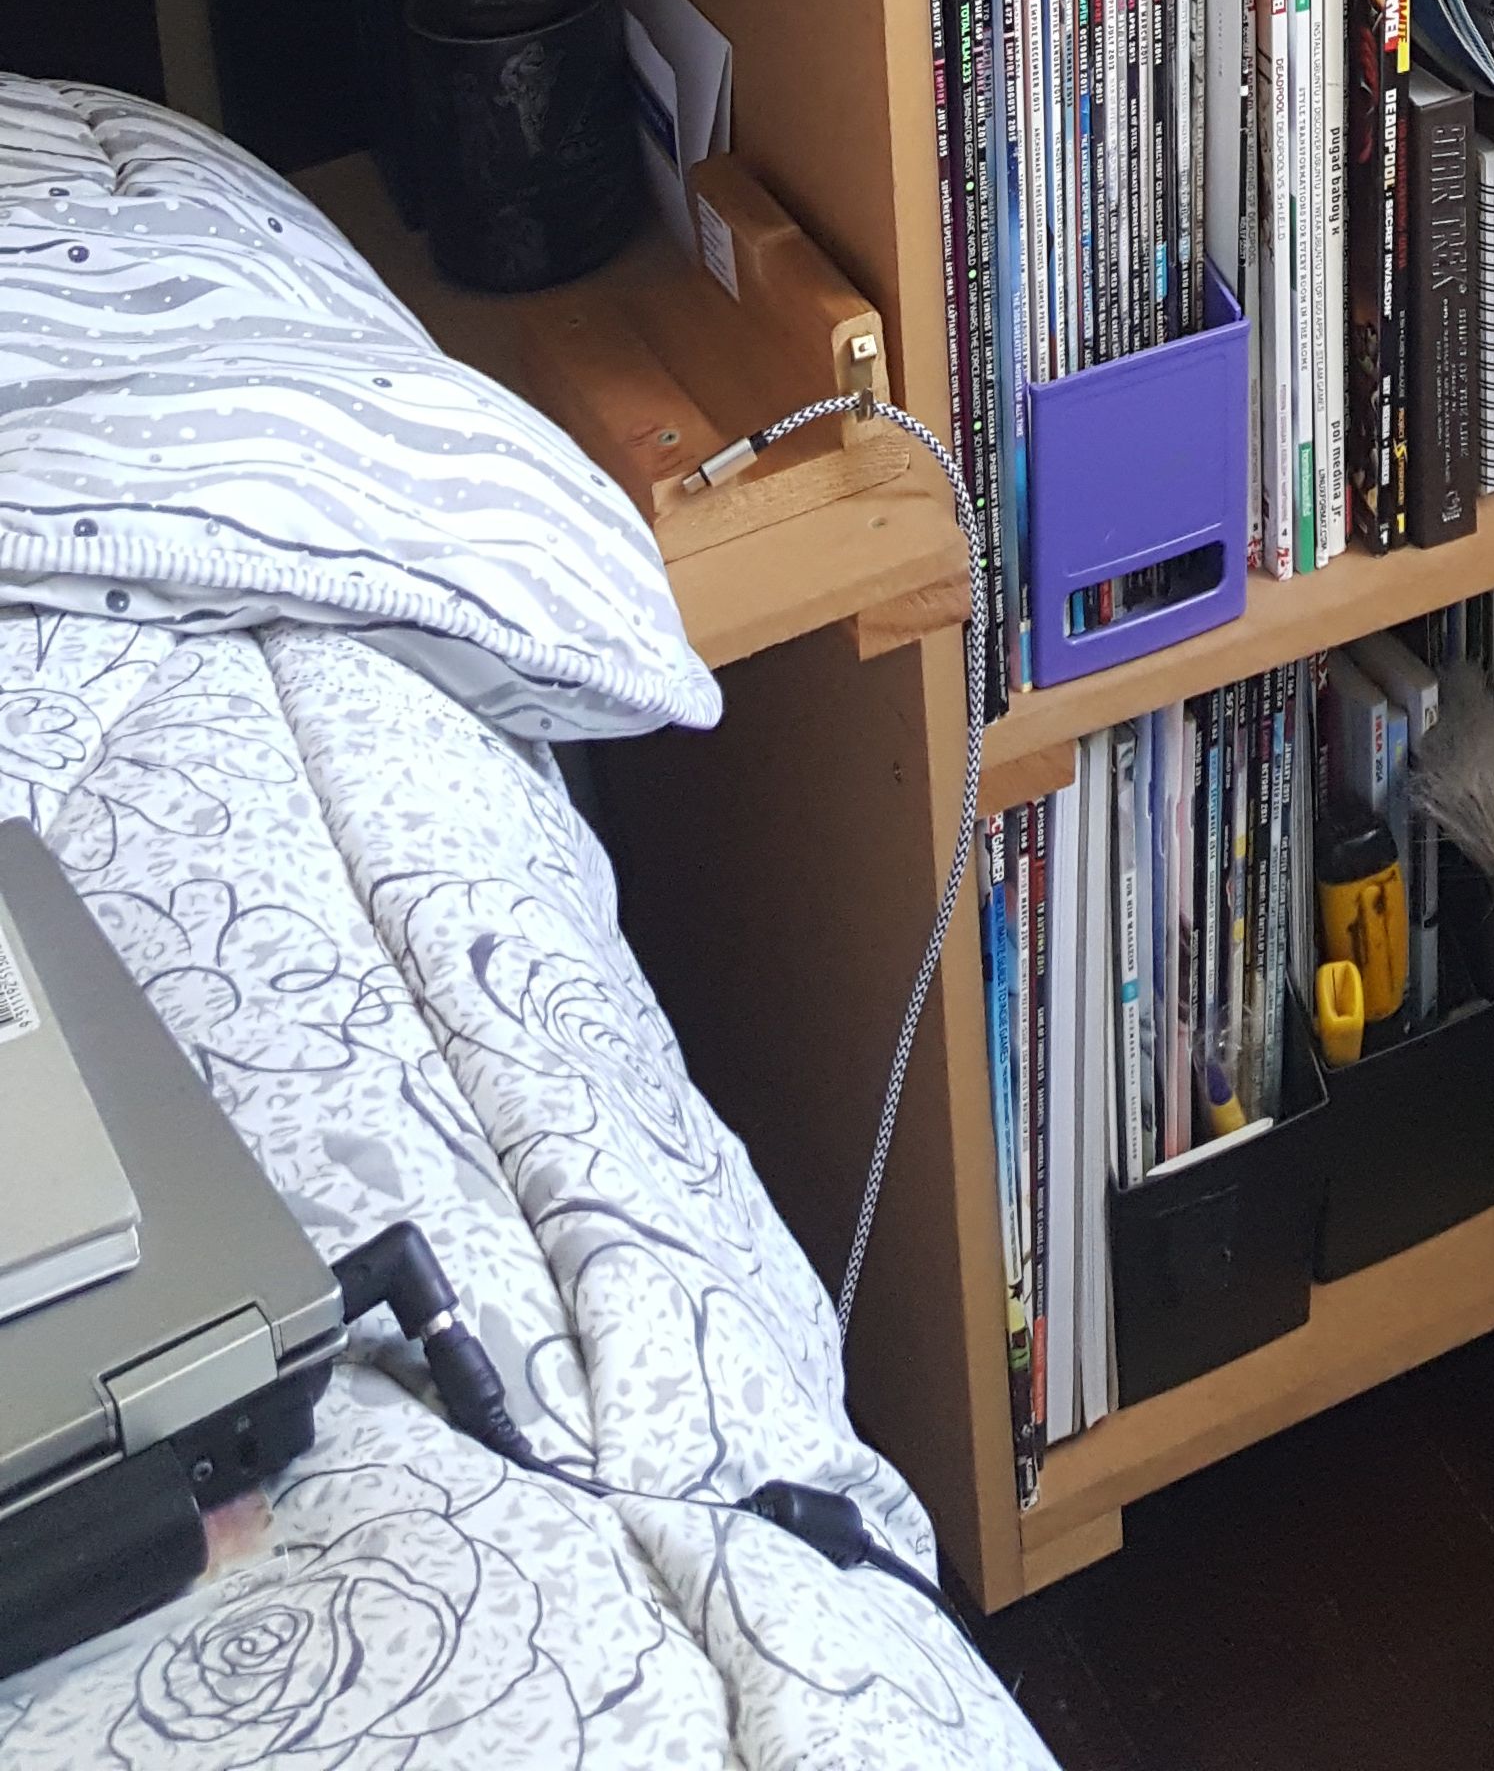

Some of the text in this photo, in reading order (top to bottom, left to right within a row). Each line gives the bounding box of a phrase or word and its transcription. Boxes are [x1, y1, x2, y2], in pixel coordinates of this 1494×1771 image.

[1128, 12, 1136, 40] APRIL
[1154, 4, 1162, 65] AUGUST 2014
[1313, 22, 1322, 58] INSTALL
[1031, 39, 1040, 90] DECEMBER
[1053, 39, 1061, 79] JANUARY
[1079, 28, 1088, 69] OCTOBER
[1095, 26, 1103, 80] SEPTEMBER
[934, 30, 948, 157] 172 JULY 2015
[976, 95, 985, 125] APRIL
[1006, 80, 1016, 117] AUGUST
[1328, 127, 1342, 227] pugad baboy
[1431, 125, 1466, 204] STAR
[961, 2, 981, 418] TOTAL FILM 233 JURASSIC WORLD STAR THE FORCE AWAKENS
[1384, 199, 1393, 249] SECRET
[982, 271, 991, 288] FAST
[950, 375, 959, 394] CIVIL
[1331, 419, 1342, 523] pol medina jr.
[992, 548, 1002, 567] FLOP
[1225, 692, 1234, 715] SFX
[1261, 763, 1270, 801] OCTOBER
[1282, 743, 1292, 781] JANUARY
[991, 815, 1004, 883] PC GAMER
[1126, 900, 1134, 919] HIM
[1126, 922, 1134, 972] MAGAZINE
